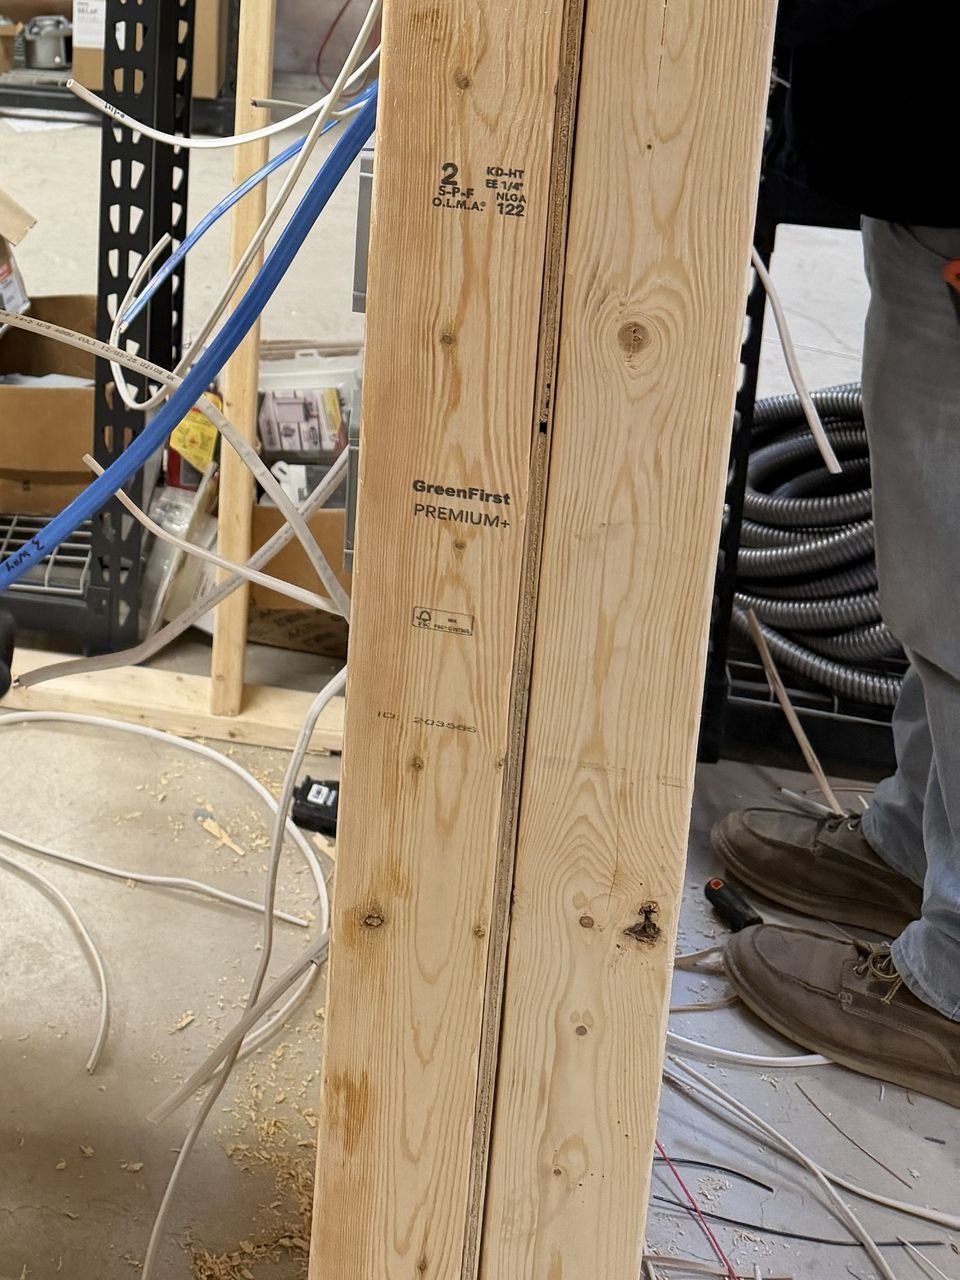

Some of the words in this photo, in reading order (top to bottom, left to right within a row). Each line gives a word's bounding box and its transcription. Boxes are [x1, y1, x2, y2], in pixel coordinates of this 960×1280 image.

[441, 162, 459, 186] 2
[486, 166, 525, 180] KD-HT
[438, 185, 475, 199] S-P-F
[496, 192, 527, 204] NLGA
[497, 202, 525, 217] 122
[412, 479, 511, 505] GreenFirst
[414, 503, 510, 528] PREMIUM+
